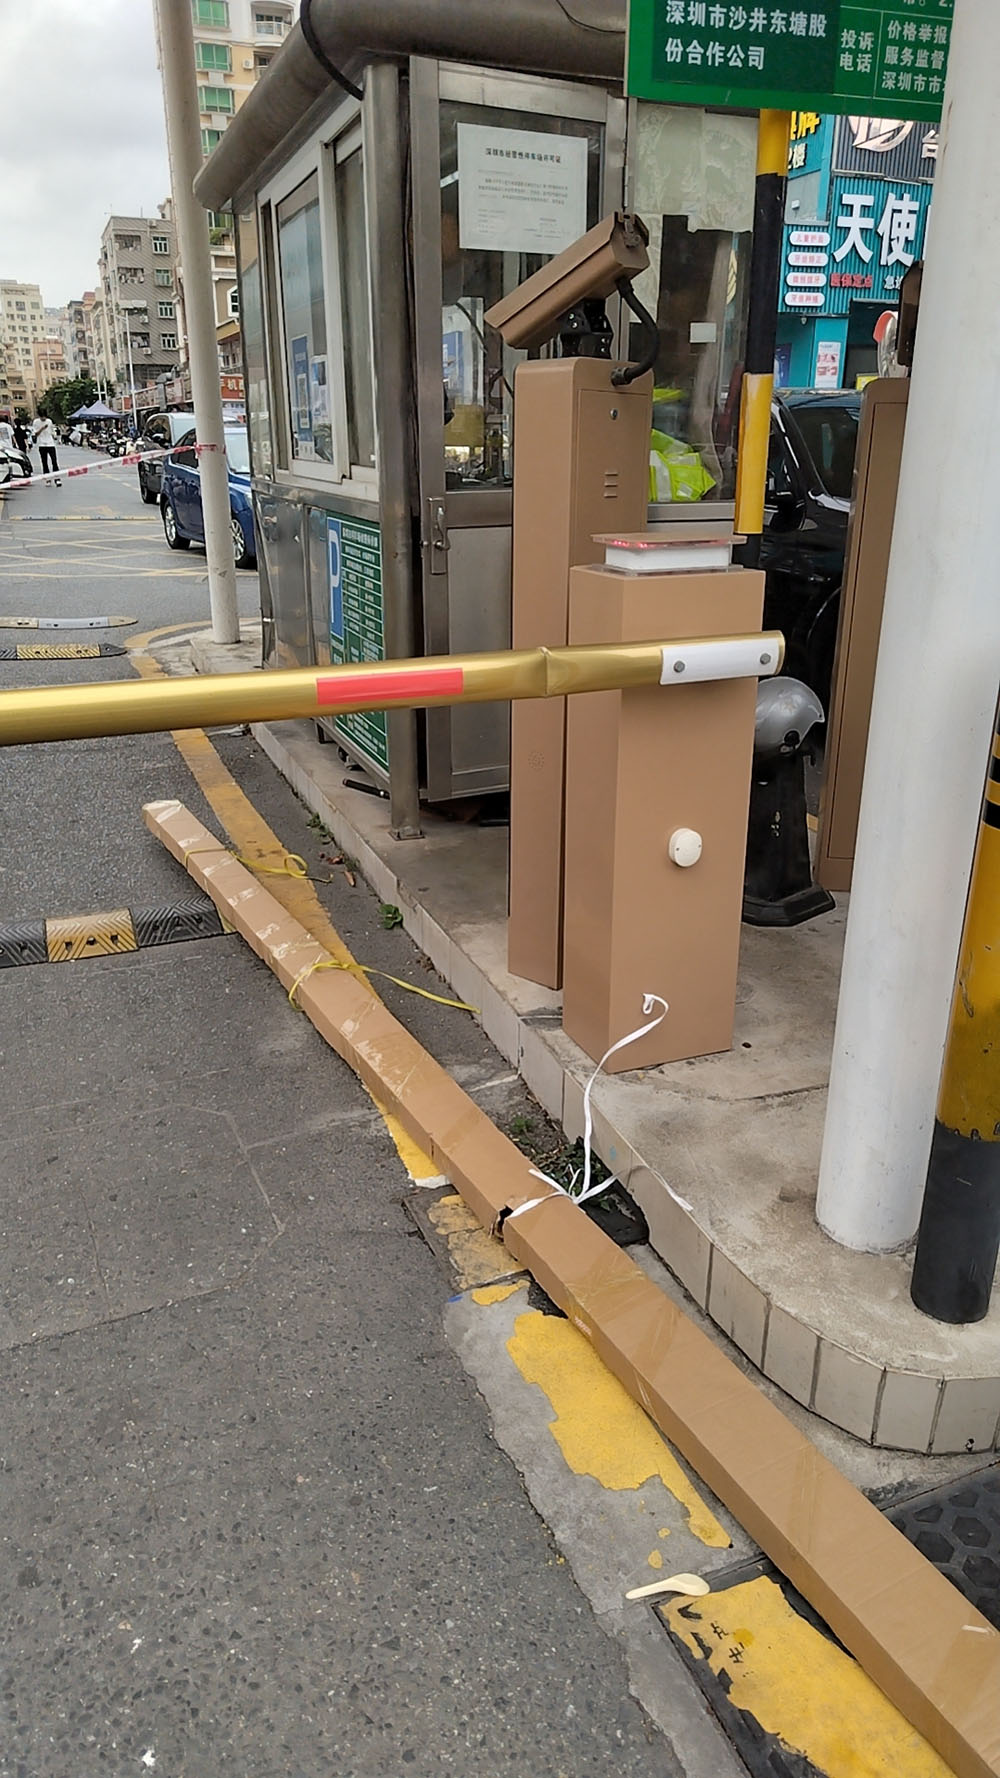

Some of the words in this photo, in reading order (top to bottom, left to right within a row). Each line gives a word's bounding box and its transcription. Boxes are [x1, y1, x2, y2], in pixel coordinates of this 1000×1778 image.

[666, 0, 828, 38] 深圳市沙井东塘股
[840, 28, 875, 51] 投诉
[887, 20, 948, 45] 价格举报
[665, 37, 766, 71] 份合作公司
[839, 51, 873, 73] 电话
[884, 45, 945, 71] 服务监督
[881, 71, 946, 94] 深圳市市
[832, 192, 931, 268] 天使
